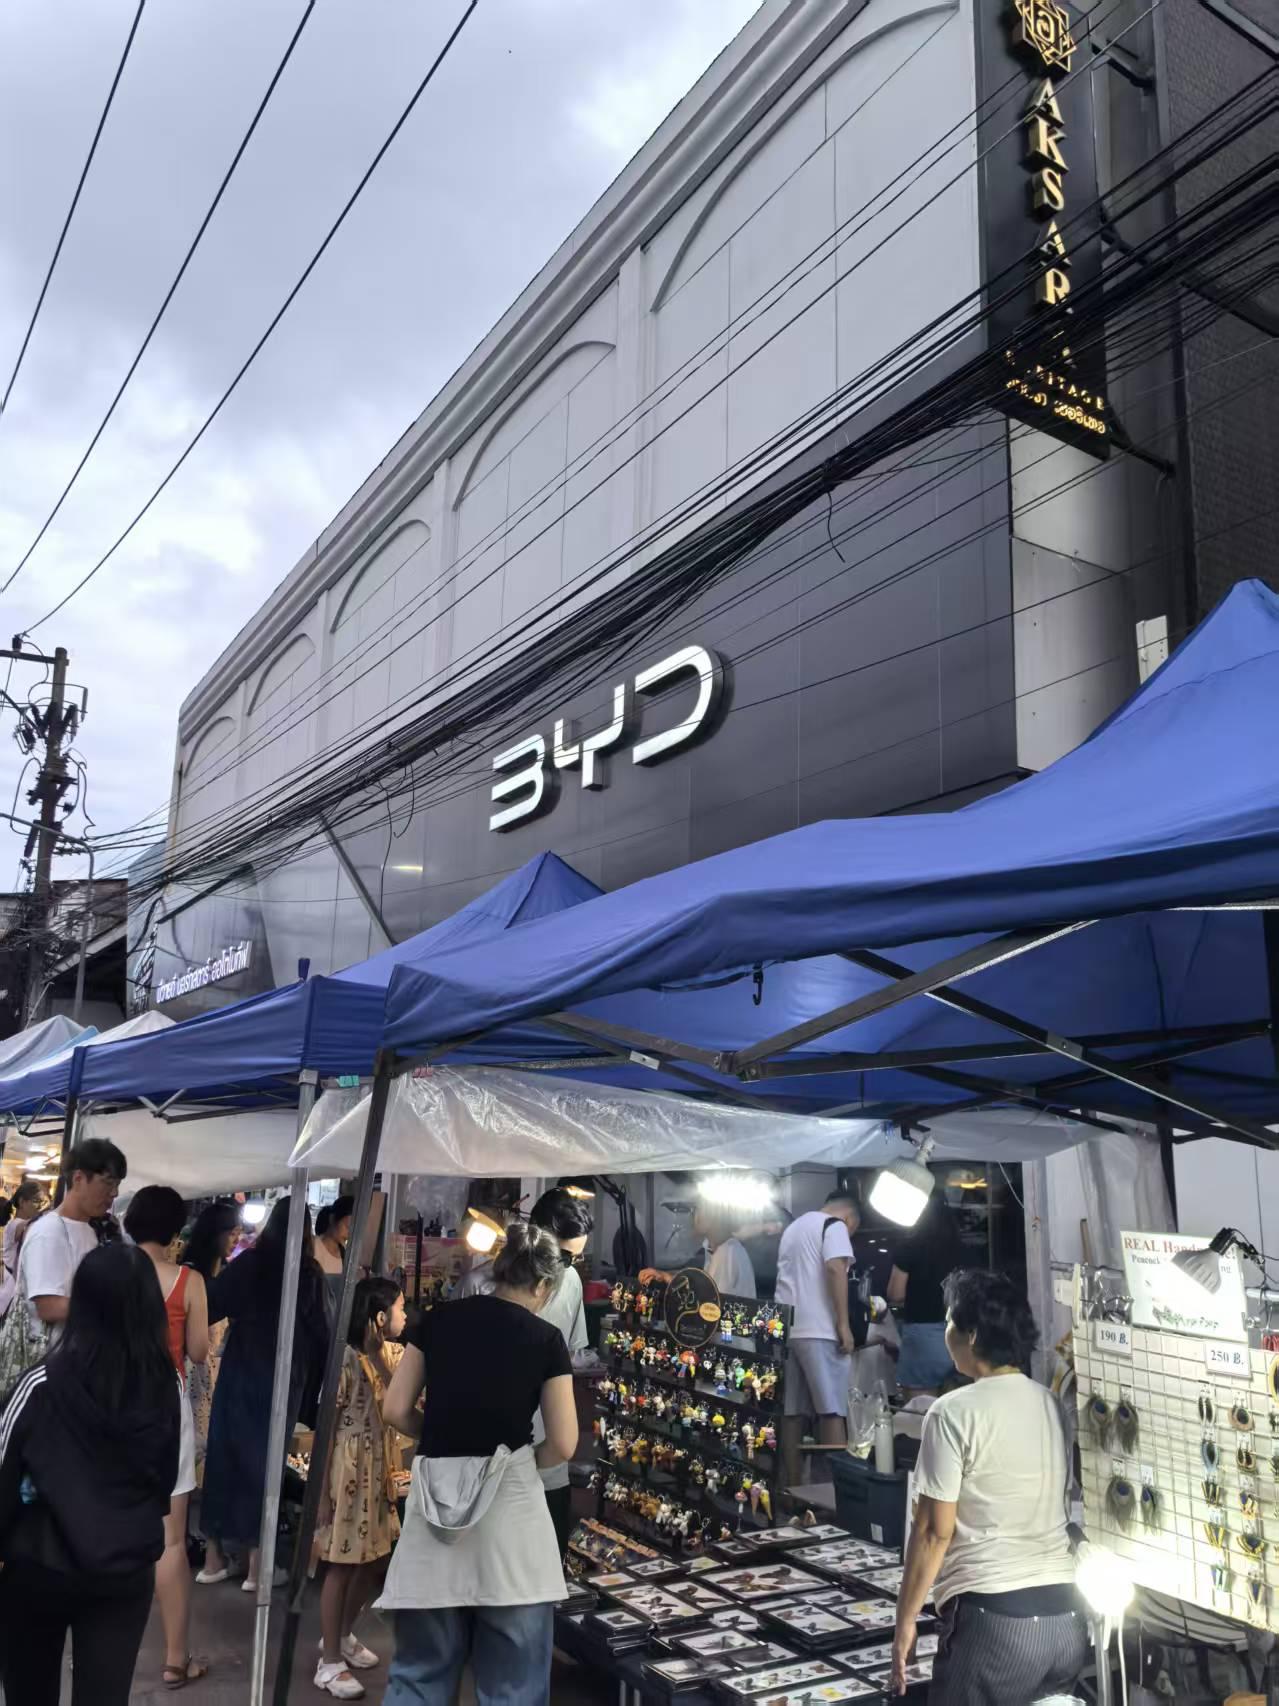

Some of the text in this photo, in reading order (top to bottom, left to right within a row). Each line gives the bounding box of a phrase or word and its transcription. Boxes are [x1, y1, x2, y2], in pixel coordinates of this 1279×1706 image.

[489, 645, 714, 832] BYD
[1124, 1237, 1160, 1252] REAL
[1100, 1329, 1116, 1342] 190
[1211, 1350, 1230, 1363] 250
